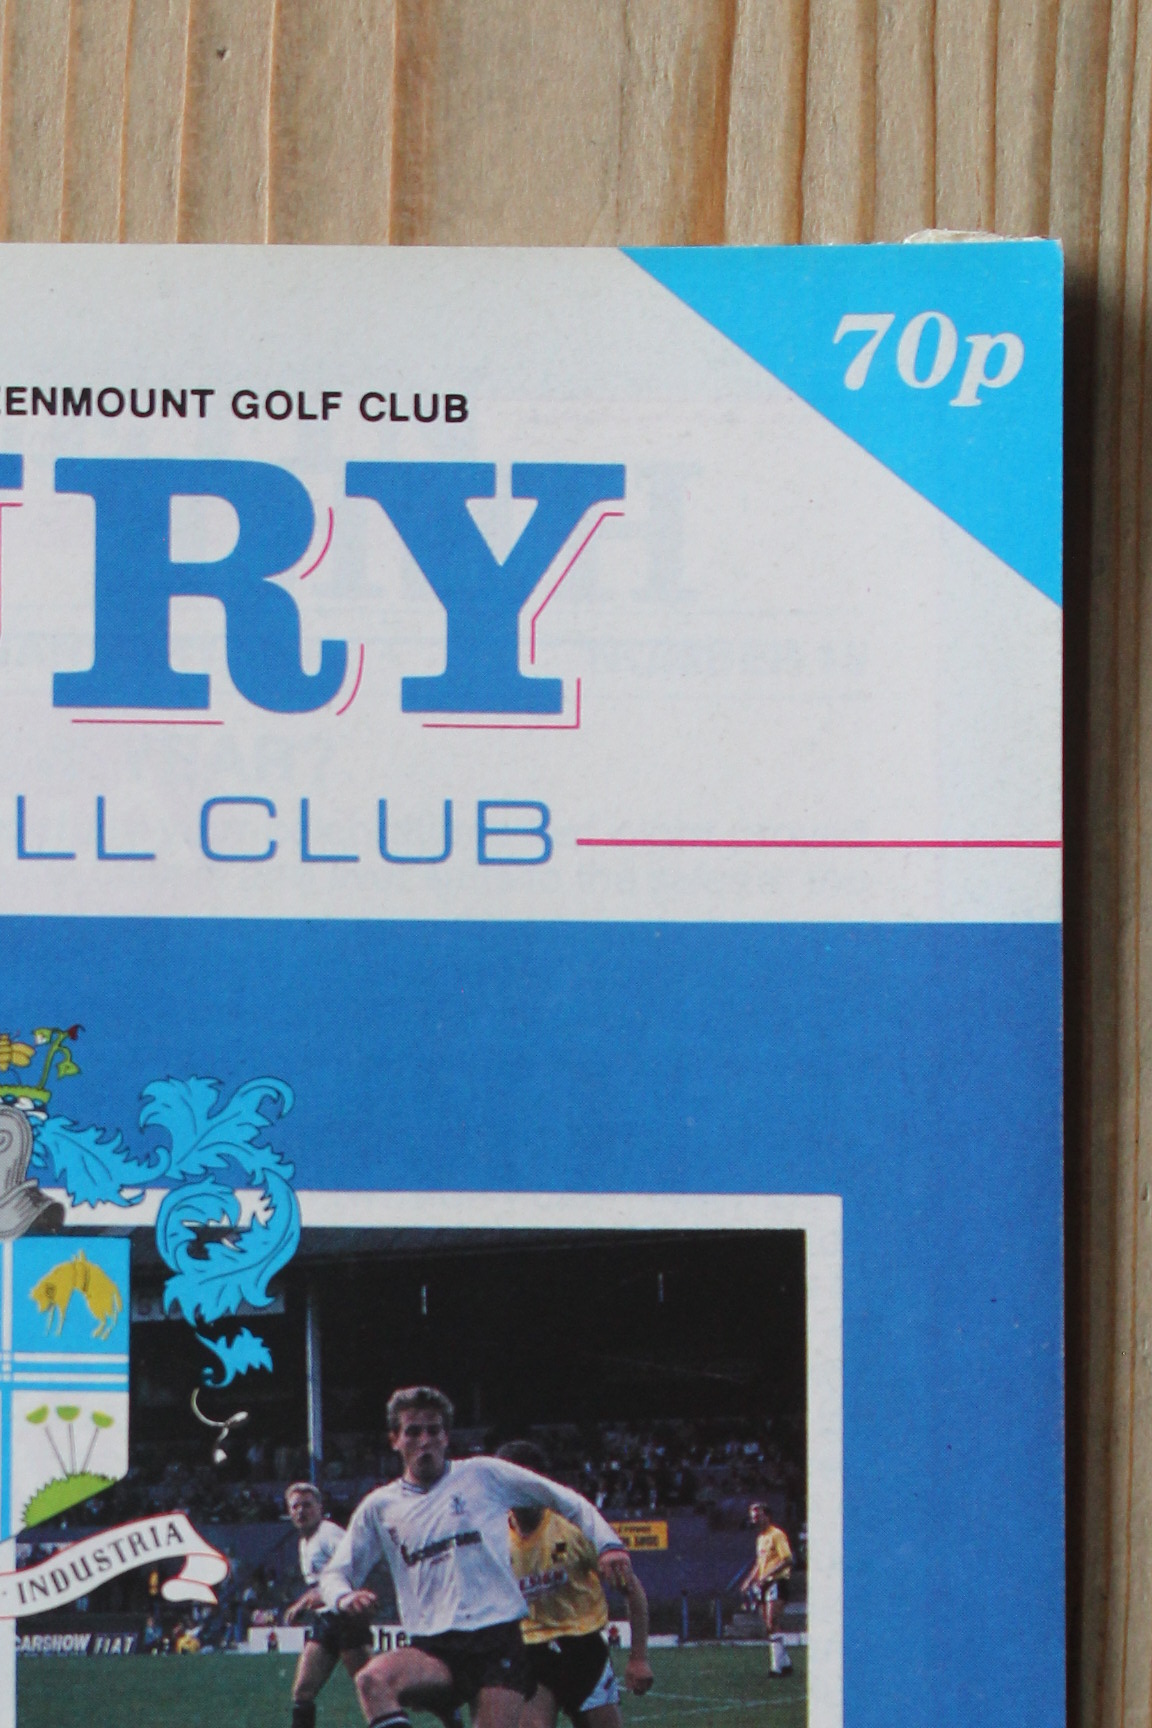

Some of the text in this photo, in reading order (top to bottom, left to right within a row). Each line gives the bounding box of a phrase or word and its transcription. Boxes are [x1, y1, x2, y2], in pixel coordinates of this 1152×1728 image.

[832, 310, 1026, 407] 70p
[231, 390, 342, 421] GOLF
[359, 392, 469, 423] CLUB
[200, 795, 554, 866] CLUB
[17, 1519, 185, 1606] INDUSTRIA
